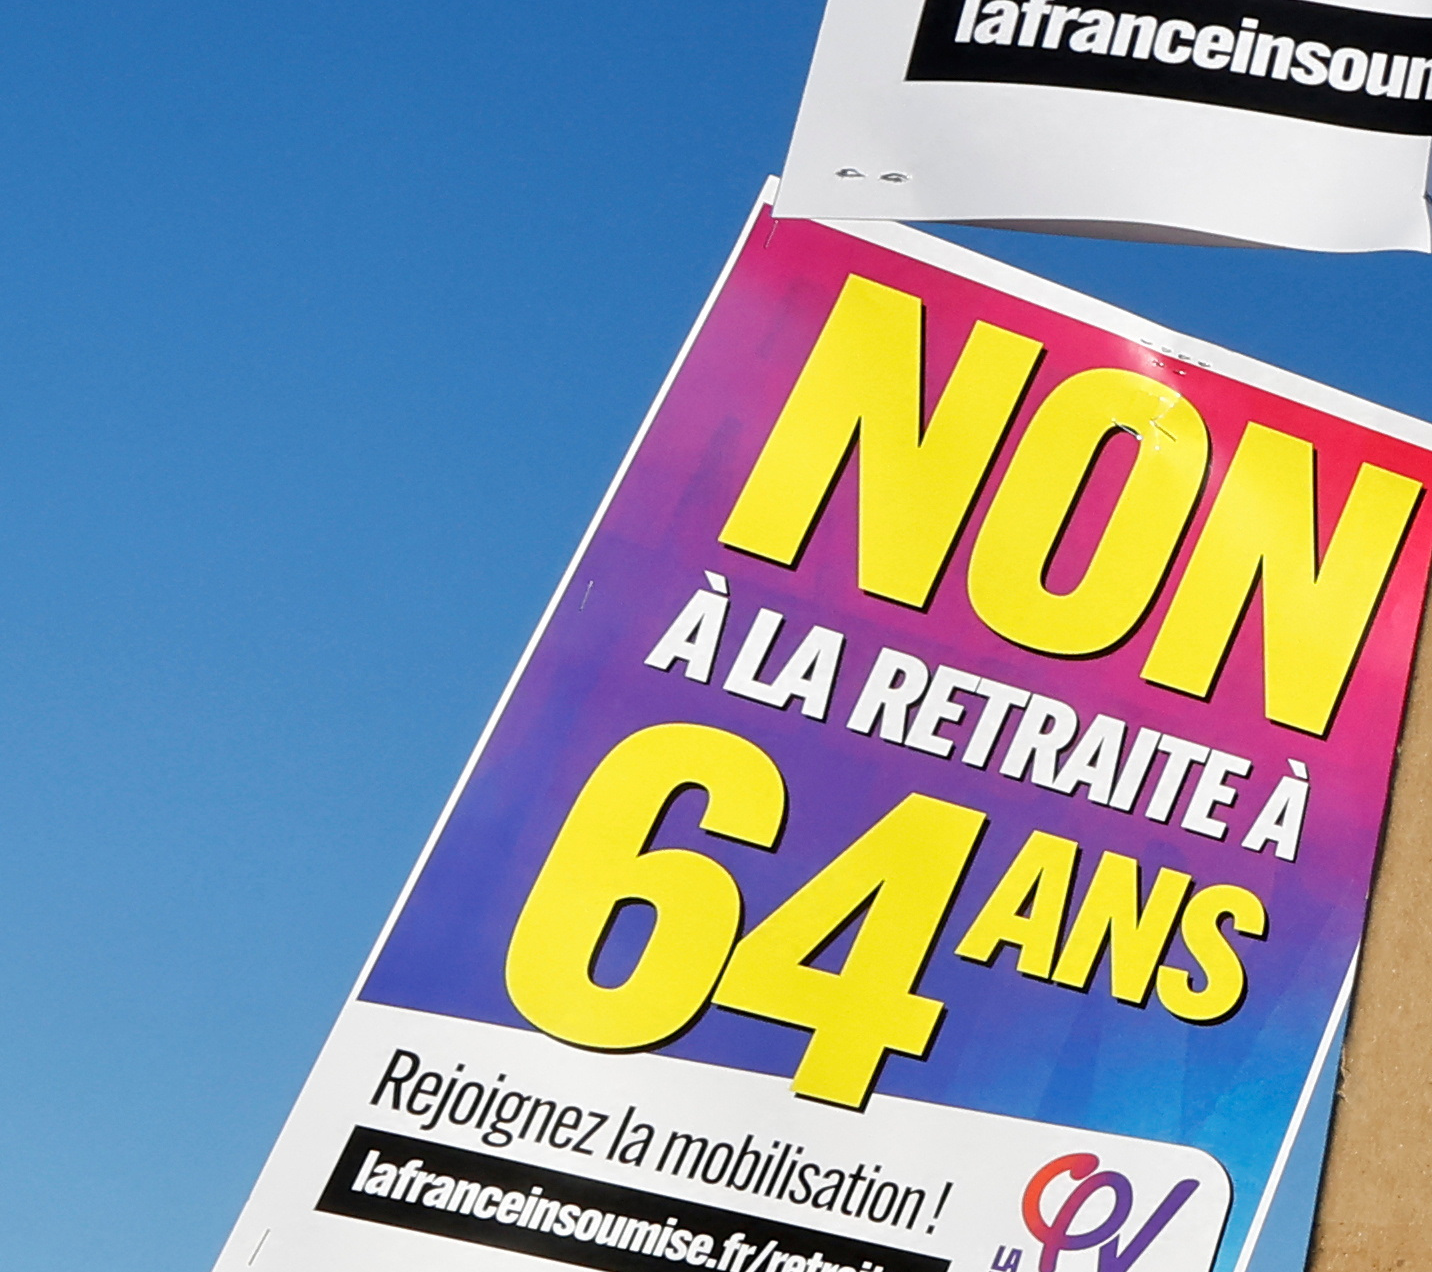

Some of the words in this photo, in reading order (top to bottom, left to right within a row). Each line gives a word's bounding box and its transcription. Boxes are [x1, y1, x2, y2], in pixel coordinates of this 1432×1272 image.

[719, 273, 1424, 737] NON
[647, 571, 730, 683] À
[725, 608, 842, 719] LA
[848, 650, 1263, 843] RETRAITE
[1242, 758, 1313, 862] À
[505, 723, 988, 1110] 64
[956, 829, 1265, 1021] ANS
[369, 1048, 610, 1154] Rejoignez
[606, 1106, 655, 1167] la
